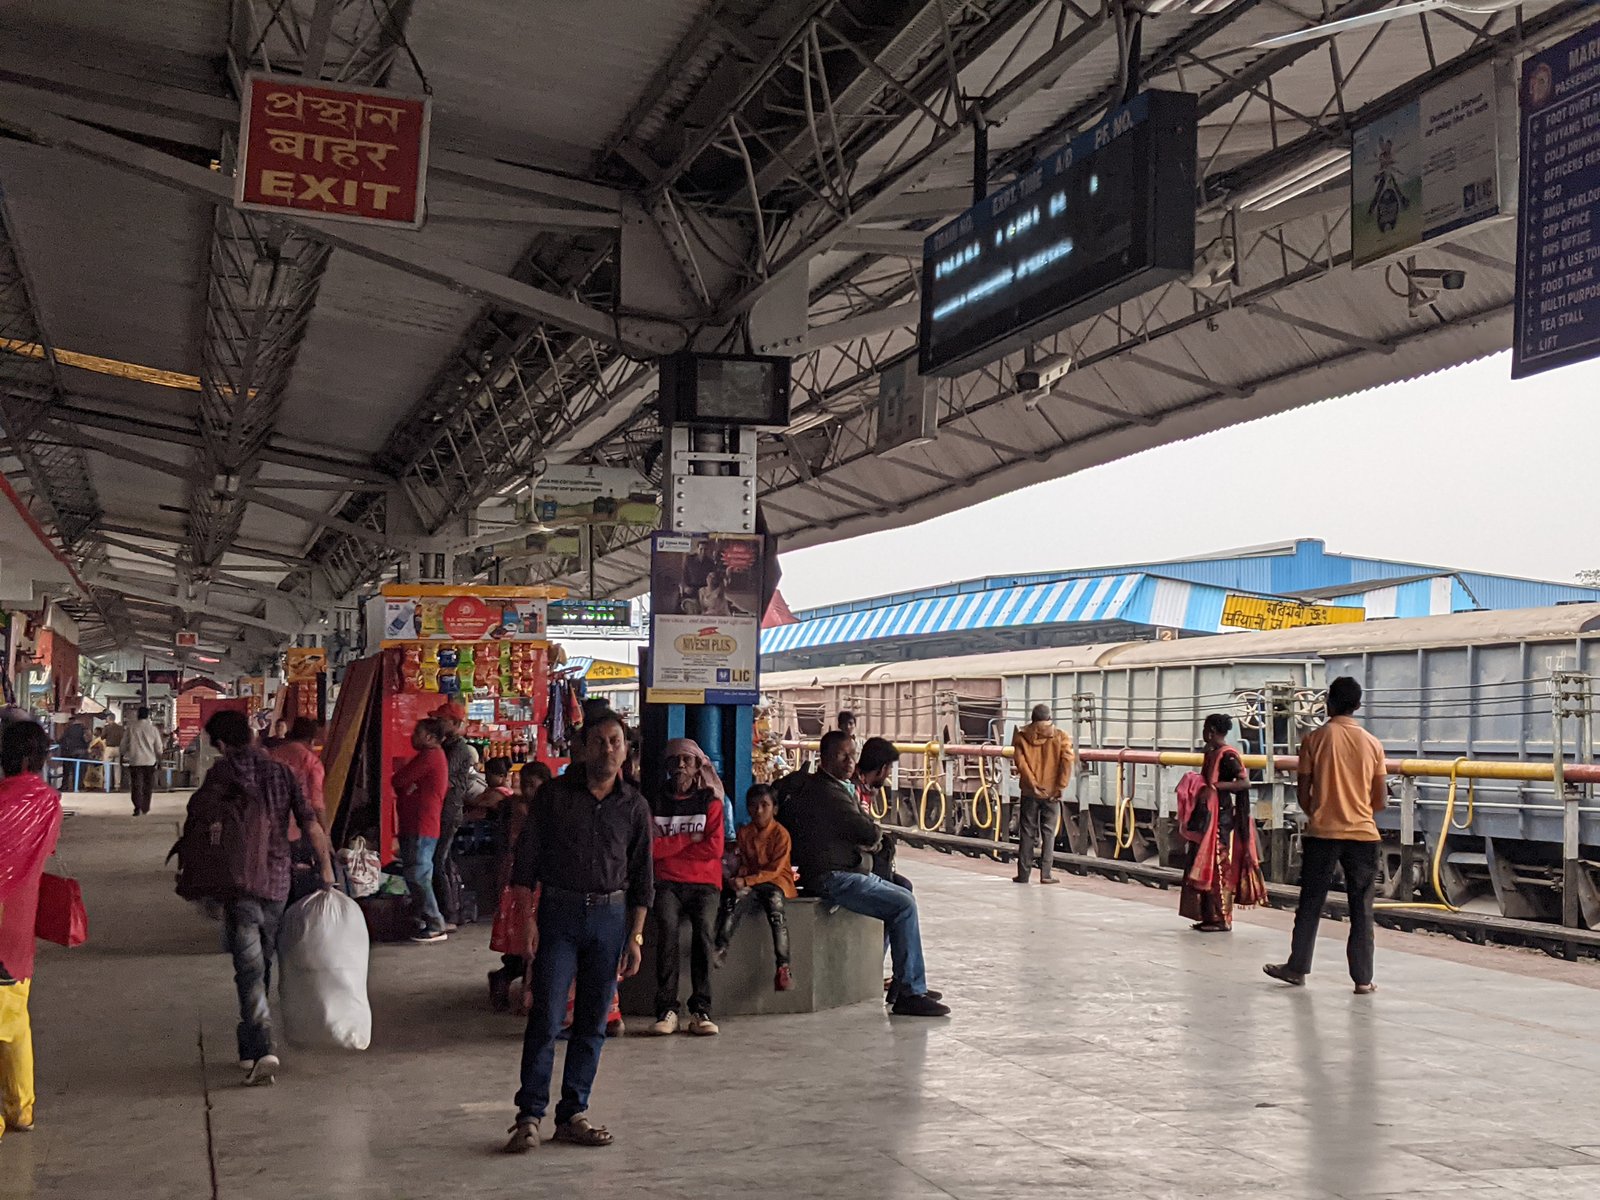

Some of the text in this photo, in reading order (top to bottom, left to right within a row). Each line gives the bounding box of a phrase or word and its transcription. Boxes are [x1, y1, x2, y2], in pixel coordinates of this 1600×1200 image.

[1546, 107, 1567, 126] FOOT
[1569, 96, 1590, 116] OVER
[264, 127, 400, 171] बाहर
[1545, 145, 1567, 164] COLD
[260, 169, 401, 210] EXIT
[1561, 210, 1591, 231] OFFICE
[1561, 229, 1591, 250] OFFICE
[1542, 261, 1557, 276] PAY
[1559, 256, 1565, 270] &
[1567, 250, 1584, 267] USE
[1541, 267, 1593, 294] FOOD TRACK
[1541, 295, 1566, 314] MULTI
[1541, 309, 1584, 332] TEA STALL
[1539, 335, 1558, 351] LIFT
[683, 637, 731, 652] NIVESH PLUS
[732, 669, 750, 682] LIC
